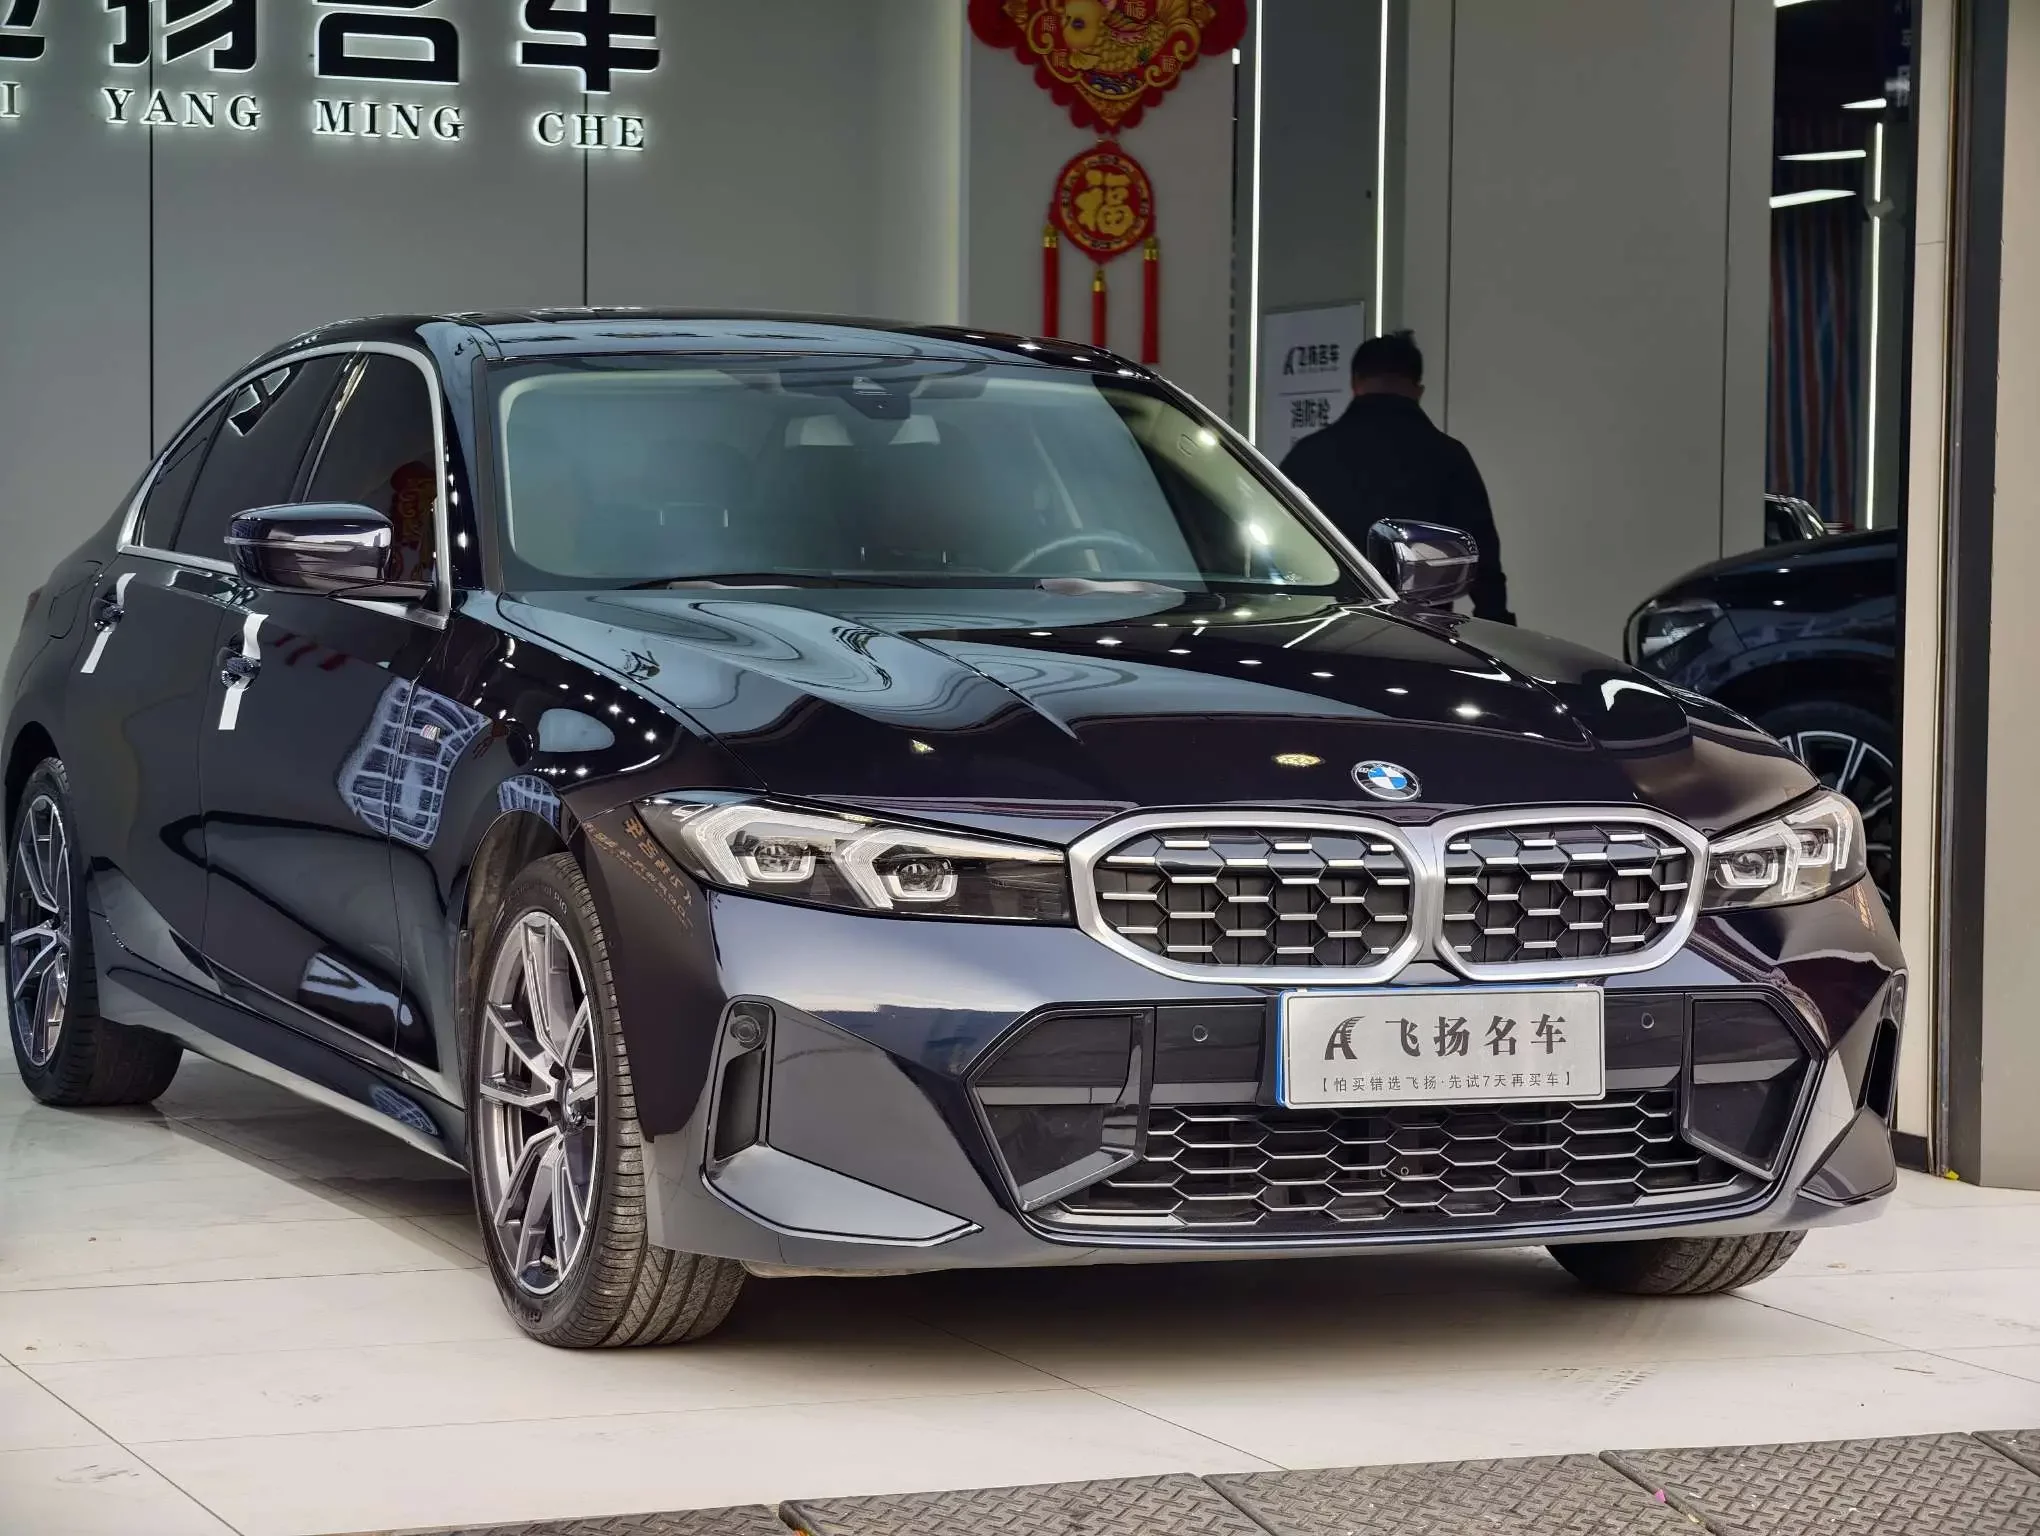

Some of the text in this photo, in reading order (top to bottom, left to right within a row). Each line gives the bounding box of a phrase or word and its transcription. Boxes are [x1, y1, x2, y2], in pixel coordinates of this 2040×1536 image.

[101, 87, 261, 131] YANG
[312, 99, 464, 141] MING
[533, 110, 645, 151] CHE
[1075, 169, 1135, 237] 福
[1384, 1013, 1567, 1057] 飞扬名车
